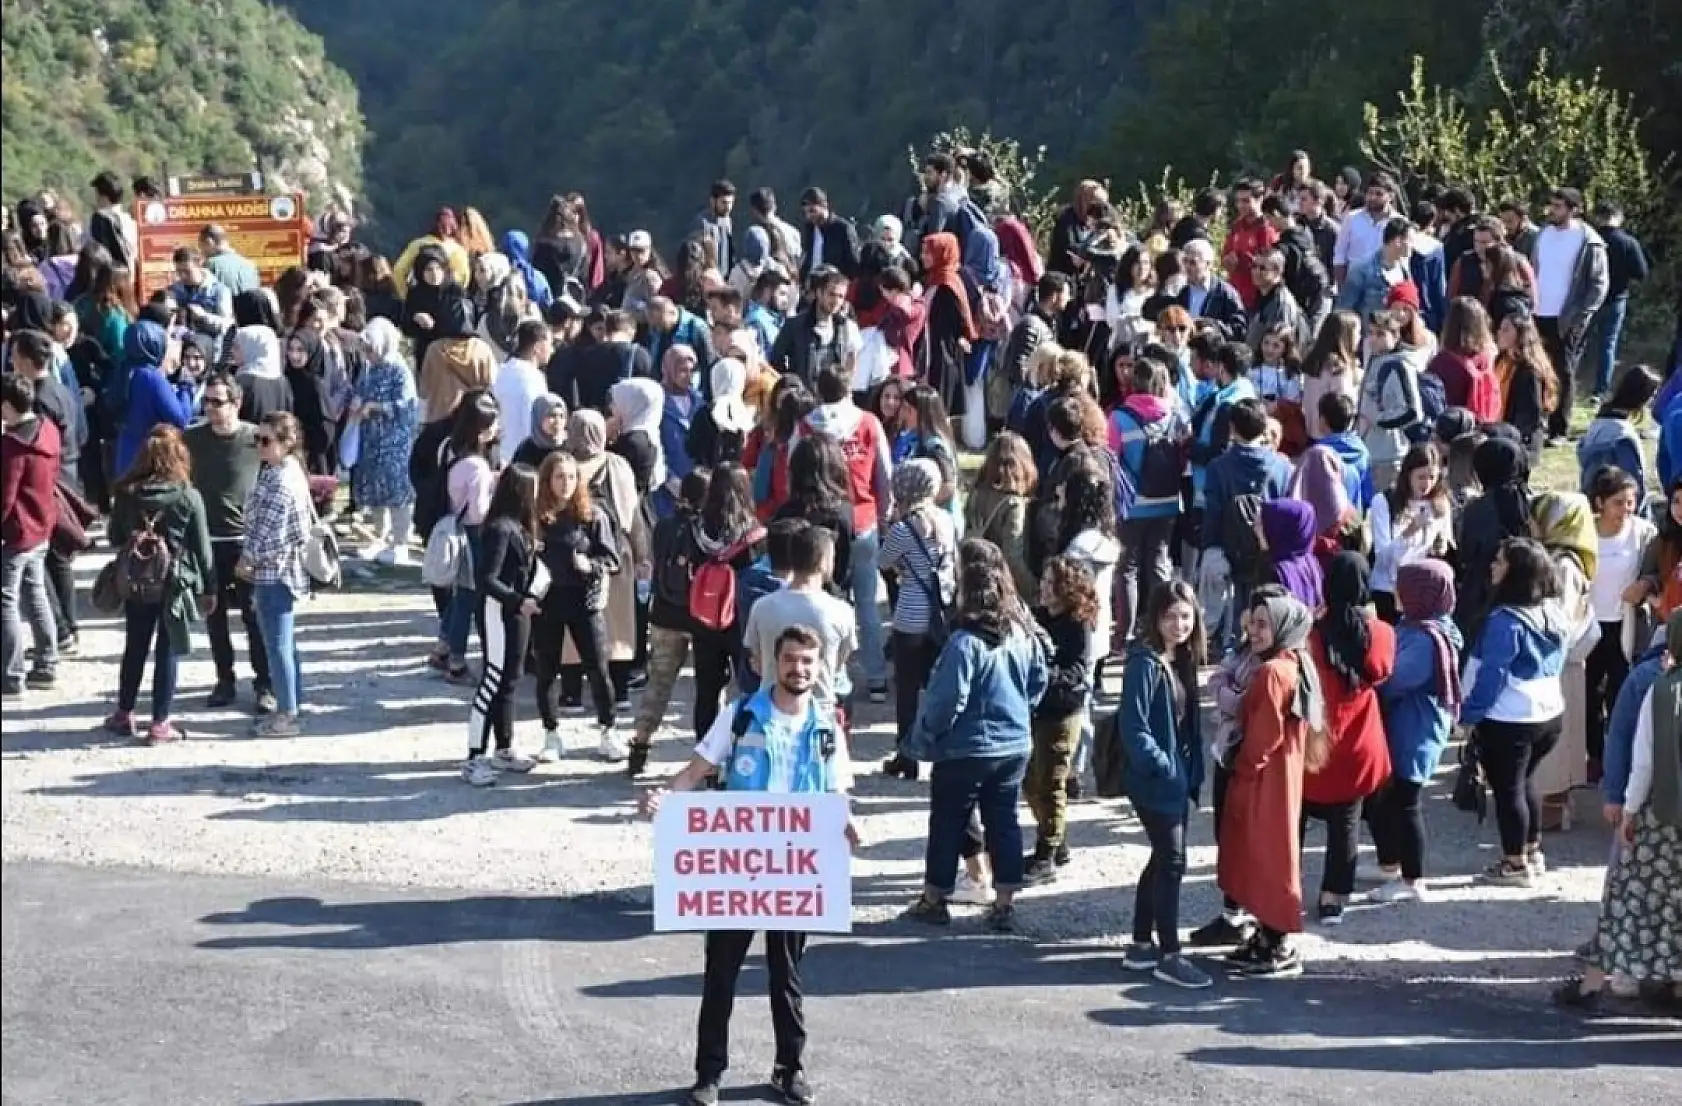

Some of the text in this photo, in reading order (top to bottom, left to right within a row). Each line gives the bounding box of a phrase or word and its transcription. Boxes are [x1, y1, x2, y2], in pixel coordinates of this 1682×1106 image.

[688, 806, 811, 832] BARTIN
[674, 841, 819, 881] GENÇLİK
[677, 884, 823, 916] MERKEZİ
